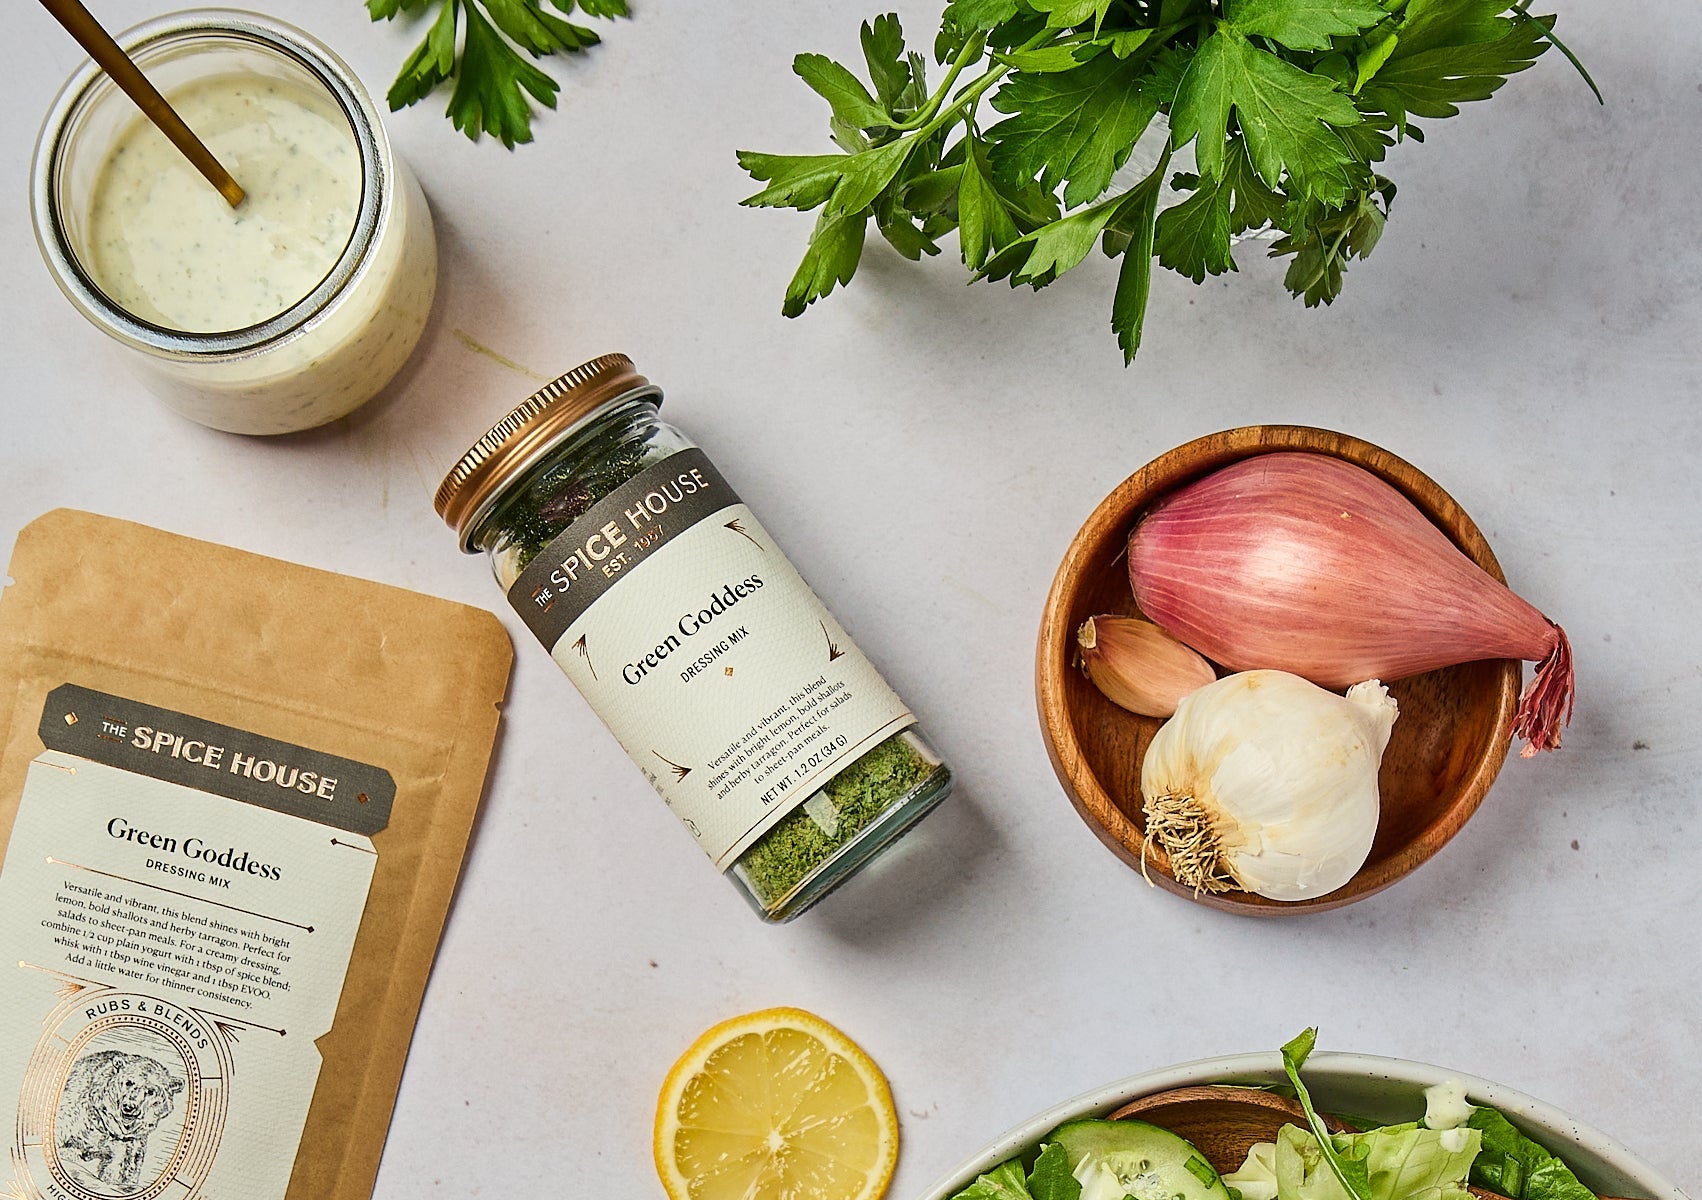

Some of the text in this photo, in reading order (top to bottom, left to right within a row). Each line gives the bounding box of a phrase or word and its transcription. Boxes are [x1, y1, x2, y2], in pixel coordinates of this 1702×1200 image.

[534, 468, 710, 607] THE SPICE HOUSE
[601, 547, 634, 579] EST.
[622, 574, 764, 686] Green Goddess
[679, 625, 750, 684] DRESSING MIX
[707, 675, 827, 770] Versatile and vibrant, this blend
[707, 769, 730, 791] shines
[728, 754, 747, 771] with
[743, 734, 772, 757] bright
[796, 697, 818, 716] bold
[817, 680, 846, 703] shallots
[716, 783, 731, 800] and
[727, 767, 752, 789] herby
[786, 715, 818, 740] Perfect
[816, 706, 830, 719] for
[829, 691, 853, 710] salads
[753, 724, 831, 785] to sheet-pan meals.
[102, 721, 338, 802] THE SPICE HOUSE
[760, 734, 848, 806] NET WT. 1.2 OZ (34 G)
[107, 817, 282, 881] Green Goddess
[145, 858, 231, 890] DRESSING MIX
[57, 909, 87, 923] salads
[88, 916, 99, 926] to
[99, 919, 147, 939] sheet-pan
[148, 933, 177, 947] meals.
[179, 939, 197, 951] For
[197, 946, 203, 954] a
[205, 948, 240, 965] creamy
[64, 880, 291, 949] Versatile and vibrant, this blend shines with bright
[88, 900, 111, 915] bold
[111, 908, 149, 925] shallots
[149, 919, 169, 930] and
[169, 922, 197, 939] herby
[242, 942, 275, 959] Perfect
[277, 951, 292, 963] for
[40, 919, 82, 936] combine
[96, 934, 115, 946] cup
[115, 937, 140, 951] plain
[140, 945, 173, 960] yogurt
[174, 954, 195, 966] with
[202, 959, 223, 974] tbsp
[224, 967, 237, 976] of
[236, 971, 261, 983] spice
[54, 936, 80, 950] whisk
[82, 943, 102, 955] with
[109, 949, 131, 964] tbsp
[133, 957, 155, 969] wine
[157, 962, 191, 978] vinegar
[192, 973, 212, 984] and
[217, 978, 239, 993] tbsp
[240, 983, 271, 1000] EVOO.
[64, 952, 253, 1010] Add a little water for thinner consistency.
[85, 999, 209, 1049] RUBS & BLENDS
